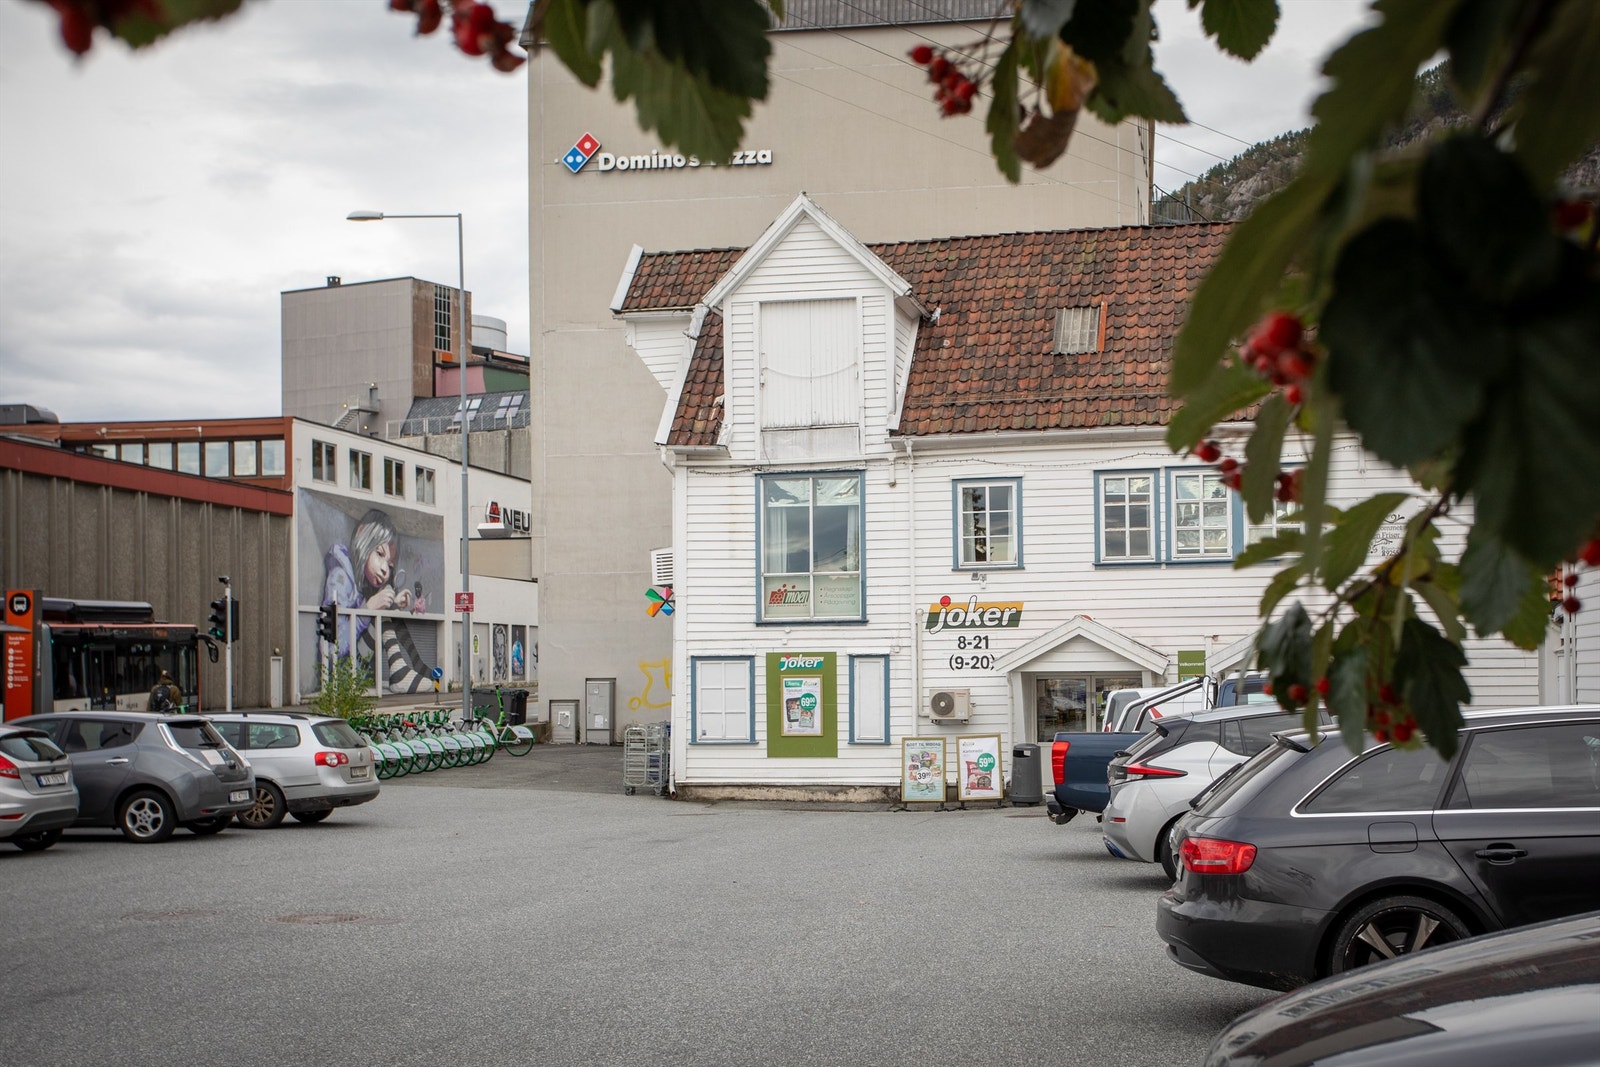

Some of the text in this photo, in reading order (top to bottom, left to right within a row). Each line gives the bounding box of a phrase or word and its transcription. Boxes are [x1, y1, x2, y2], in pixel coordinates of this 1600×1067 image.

[598, 149, 699, 172] Dominos
[928, 594, 1018, 635] joker
[957, 634, 989, 650] 8-21
[780, 653, 821, 671] joker
